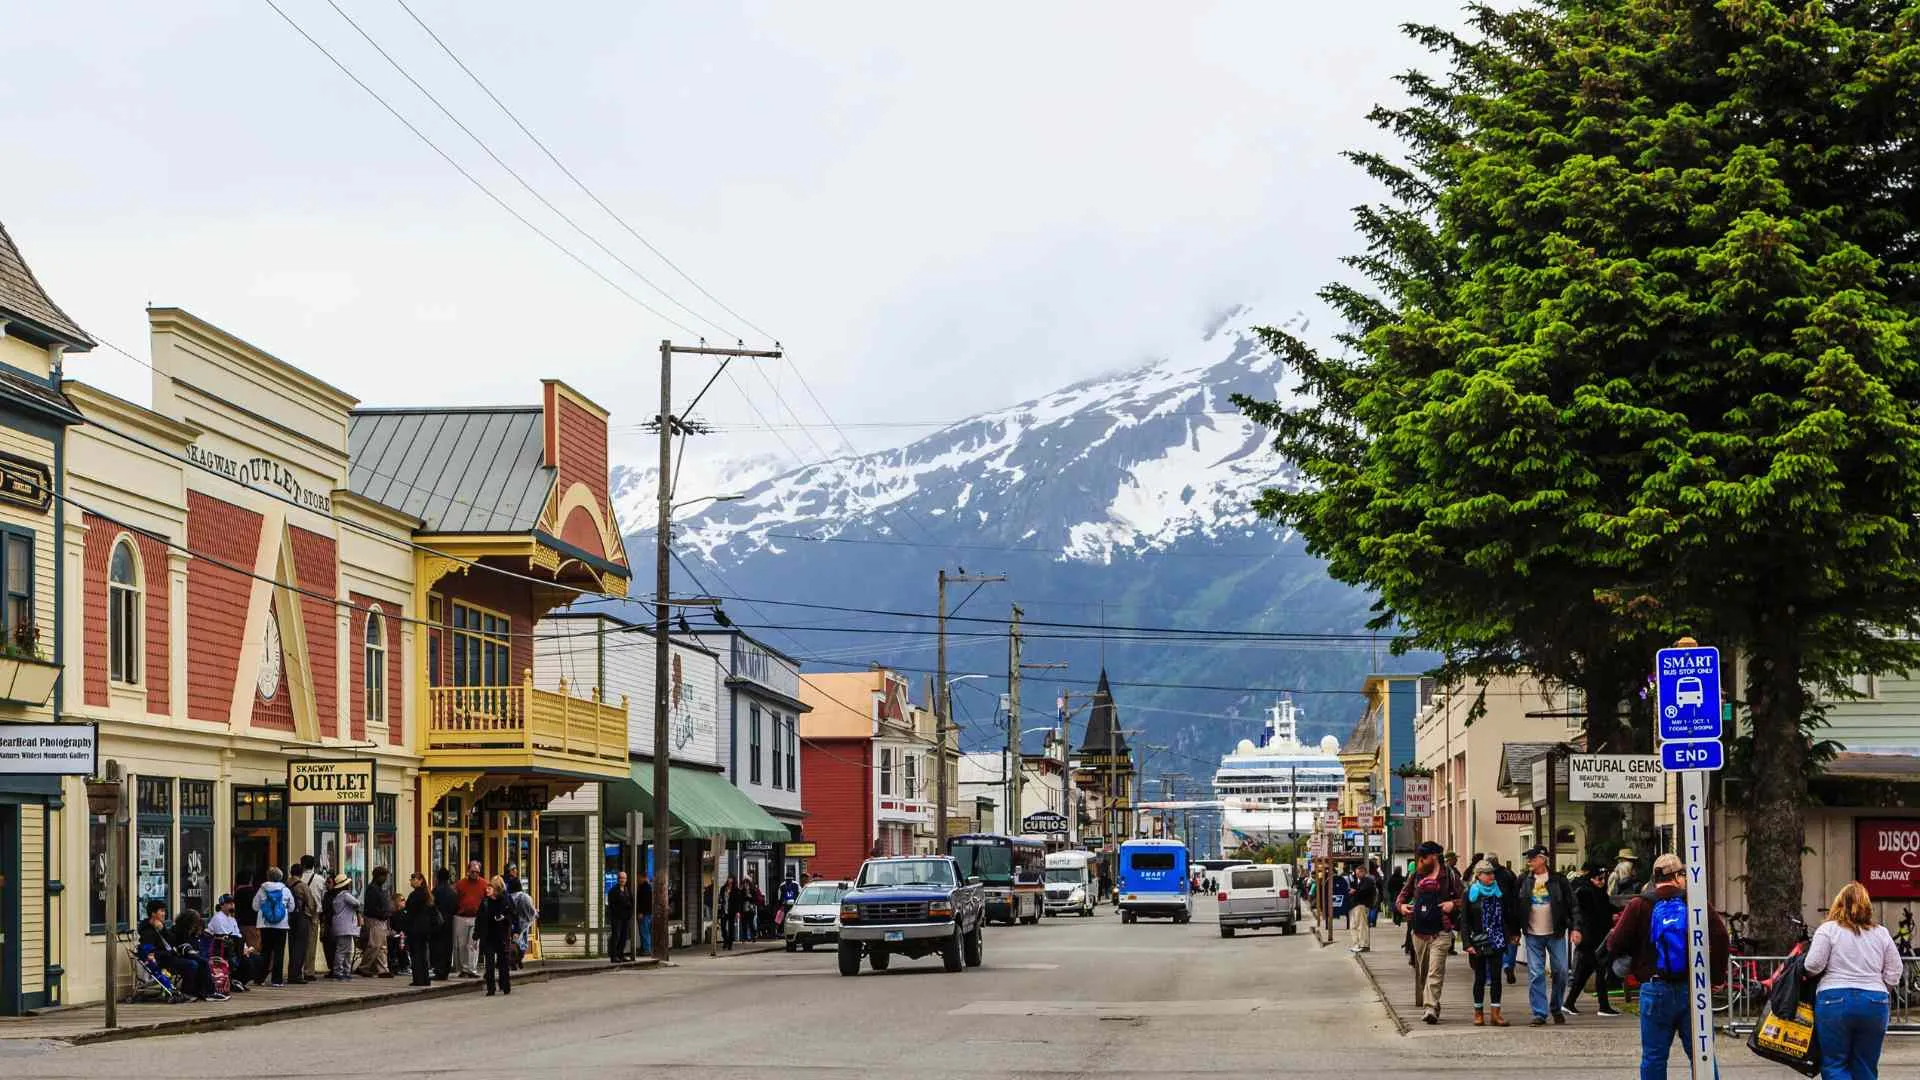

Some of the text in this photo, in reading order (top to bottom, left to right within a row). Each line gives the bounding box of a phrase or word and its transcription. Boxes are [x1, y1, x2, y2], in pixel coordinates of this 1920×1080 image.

[185, 444, 330, 513] SKAGWAY OUTLET STORE
[1663, 655, 1713, 669] SMART
[40, 736, 92, 748] Photography
[69, 752, 90, 760] Gallery
[1675, 749, 1708, 762] END
[296, 764, 335, 773] SKAGWAY
[1572, 759, 1662, 773] NATURAL GEMS
[293, 773, 369, 792] OUTLET
[1408, 783, 1416, 792] 20
[1583, 781, 1605, 789] PEARLS
[336, 791, 366, 800] STORE
[1619, 792, 1642, 800] ALASKA
[1496, 811, 1534, 822] RESTAURANT
[1024, 820, 1067, 830] CURIOS
[1870, 870, 1910, 881] SKAGWAY
[1689, 803, 1708, 1052] CITY TRANSIT
